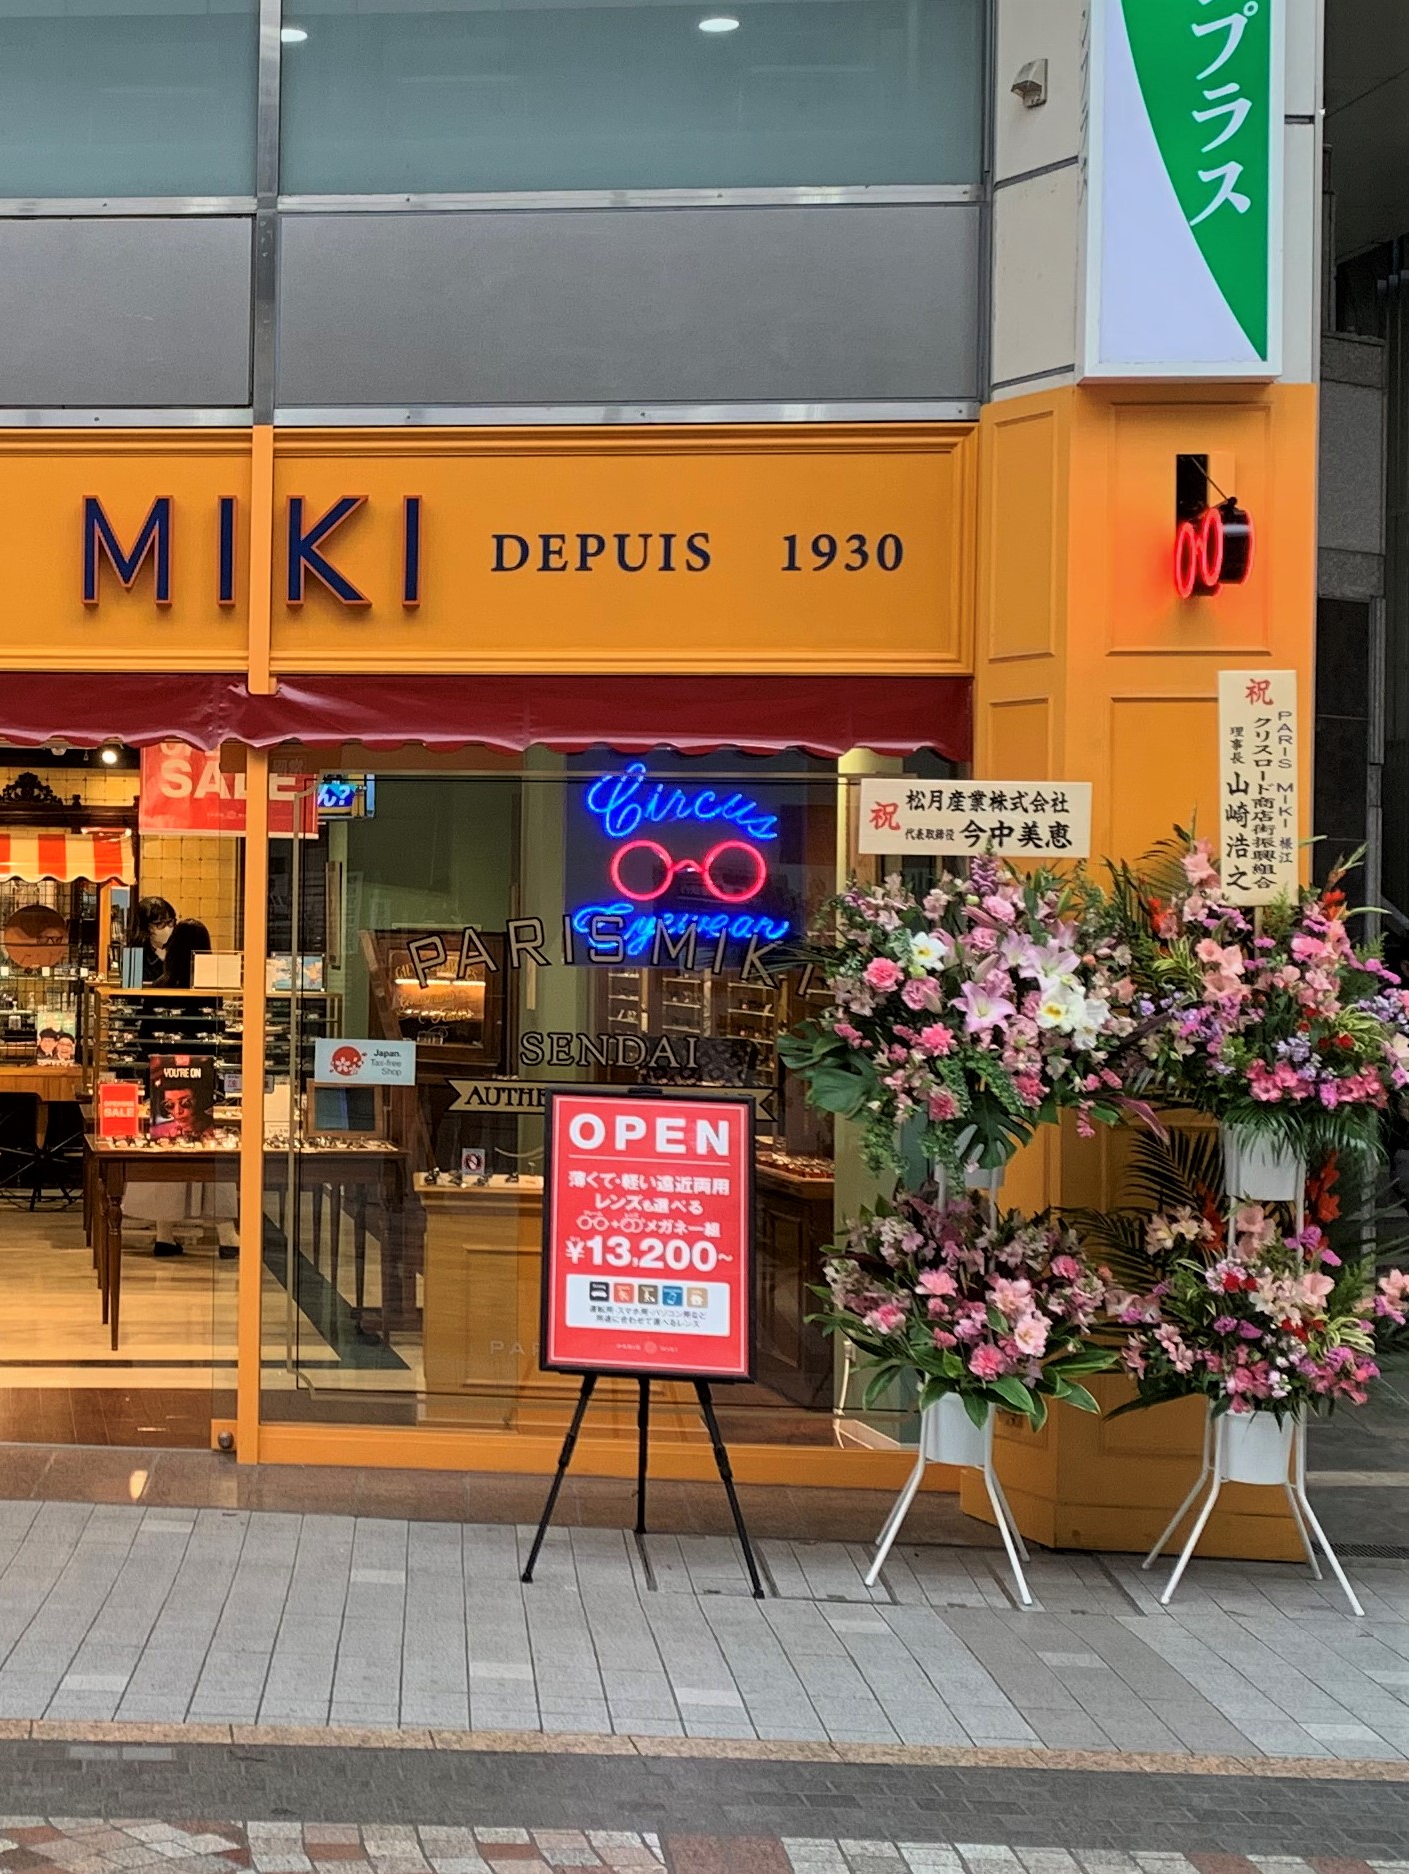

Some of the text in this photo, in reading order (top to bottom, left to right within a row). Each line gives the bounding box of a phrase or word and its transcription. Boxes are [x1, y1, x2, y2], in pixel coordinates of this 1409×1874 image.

[1190, 0, 1260, 227] プラス
[81, 494, 424, 607] MIKI
[490, 532, 905, 573] DEPUIS 1930
[1245, 678, 1274, 706] 祝
[1229, 726, 1245, 765] 理事長
[1277, 711, 1293, 769] PARIS
[587, 762, 778, 839] Circus
[869, 801, 902, 831] 祝
[905, 789, 1071, 814] 松月産業株式会社
[1277, 783, 1294, 828] MIKI
[406, 914, 625, 989] PARIS
[520, 1031, 700, 1069] SENDAI
[381, 1068, 402, 1077] Shop
[103, 1107, 135, 1118] SALE
[568, 1112, 731, 1156] OPEN
